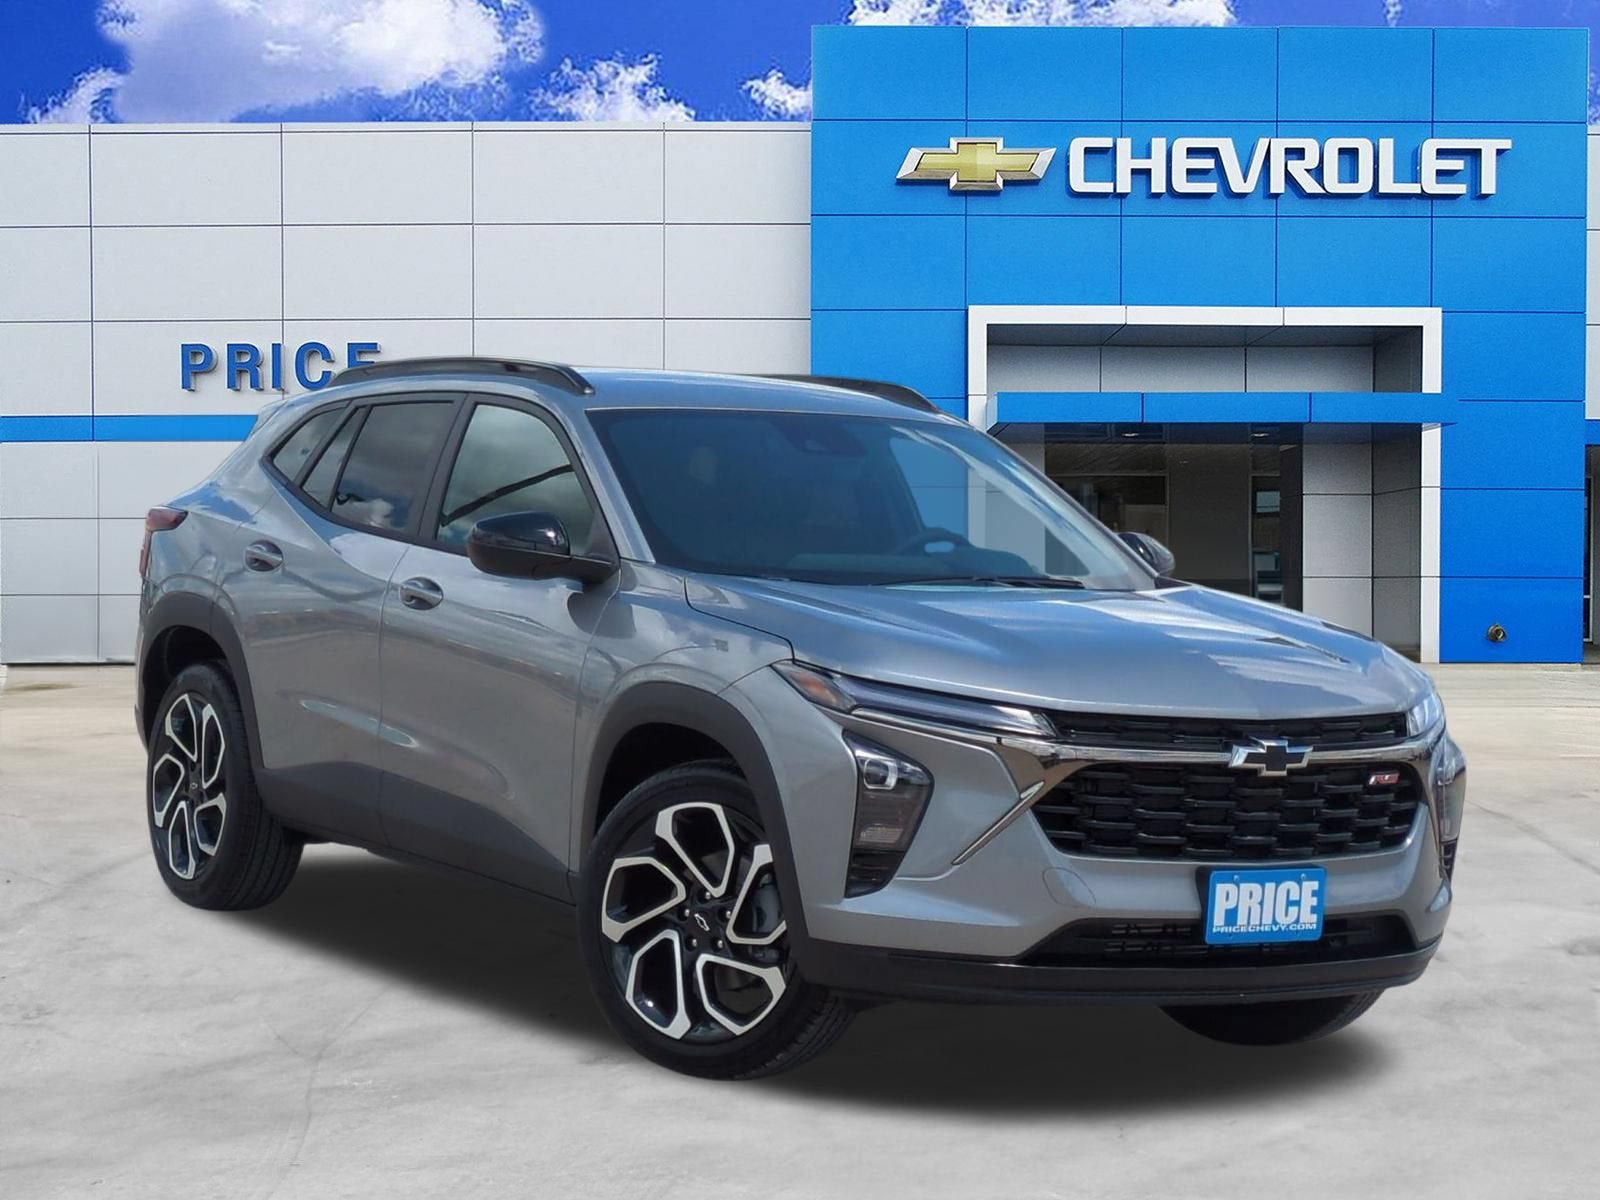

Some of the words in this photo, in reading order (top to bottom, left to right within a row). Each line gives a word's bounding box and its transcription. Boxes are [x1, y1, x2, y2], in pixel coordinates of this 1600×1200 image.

[1069, 137, 1512, 195] CHEVROLET
[1213, 881, 1319, 927] PRICE
[1212, 923, 1317, 934] PRICECHEVY.COM
